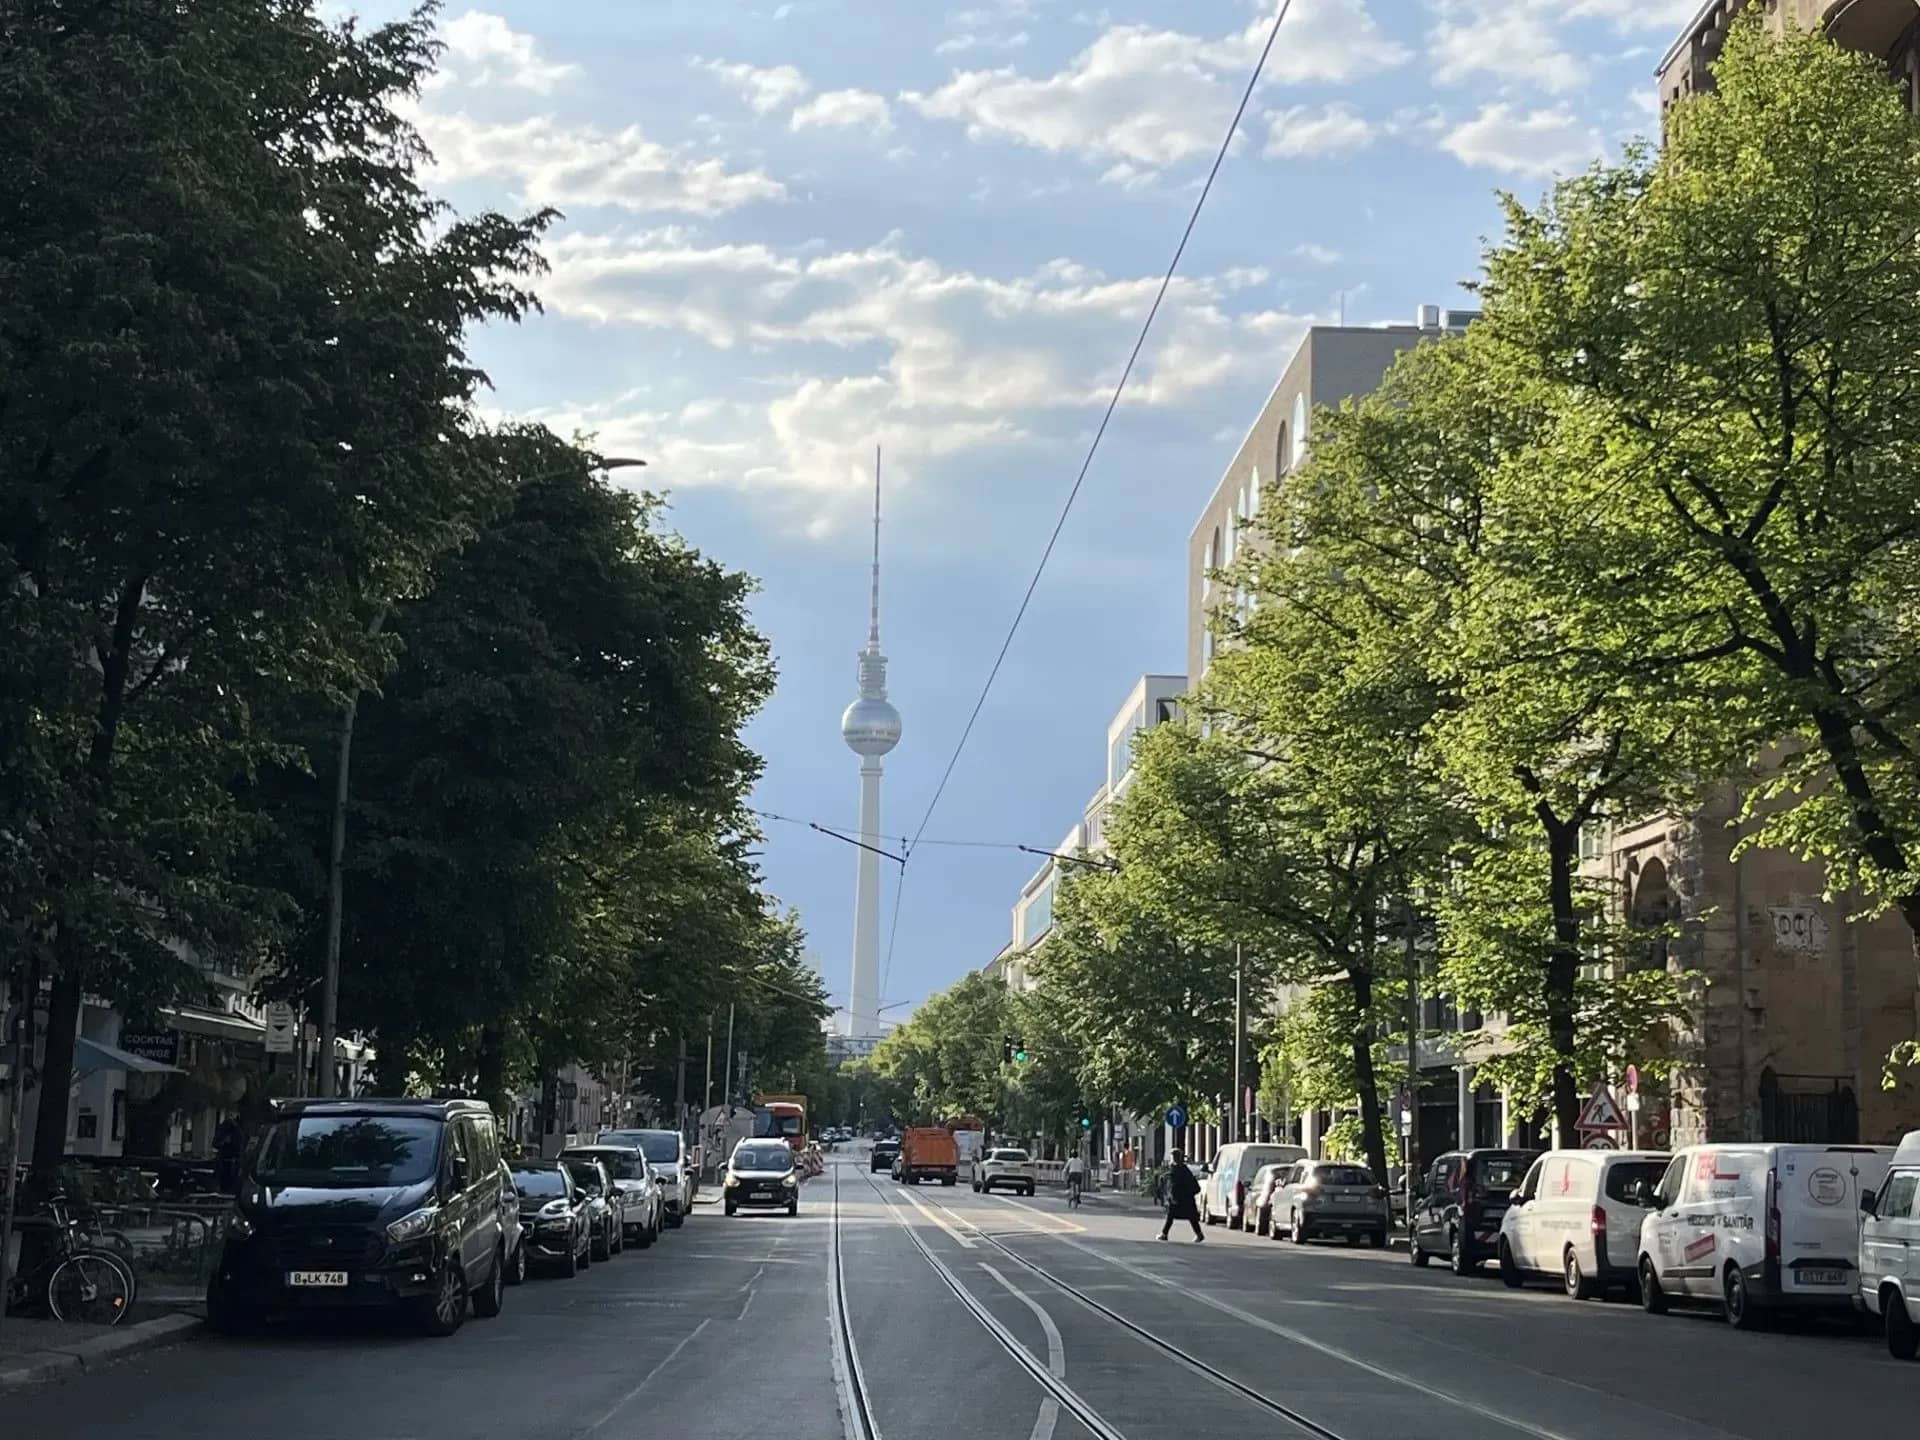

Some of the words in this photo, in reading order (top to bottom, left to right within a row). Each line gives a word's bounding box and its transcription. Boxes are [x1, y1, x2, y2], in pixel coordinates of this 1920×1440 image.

[126, 1033, 175, 1046] COCKTAIL
[128, 1047, 171, 1059] LOUNGE
[1723, 1214, 1754, 1230] SANITÄR
